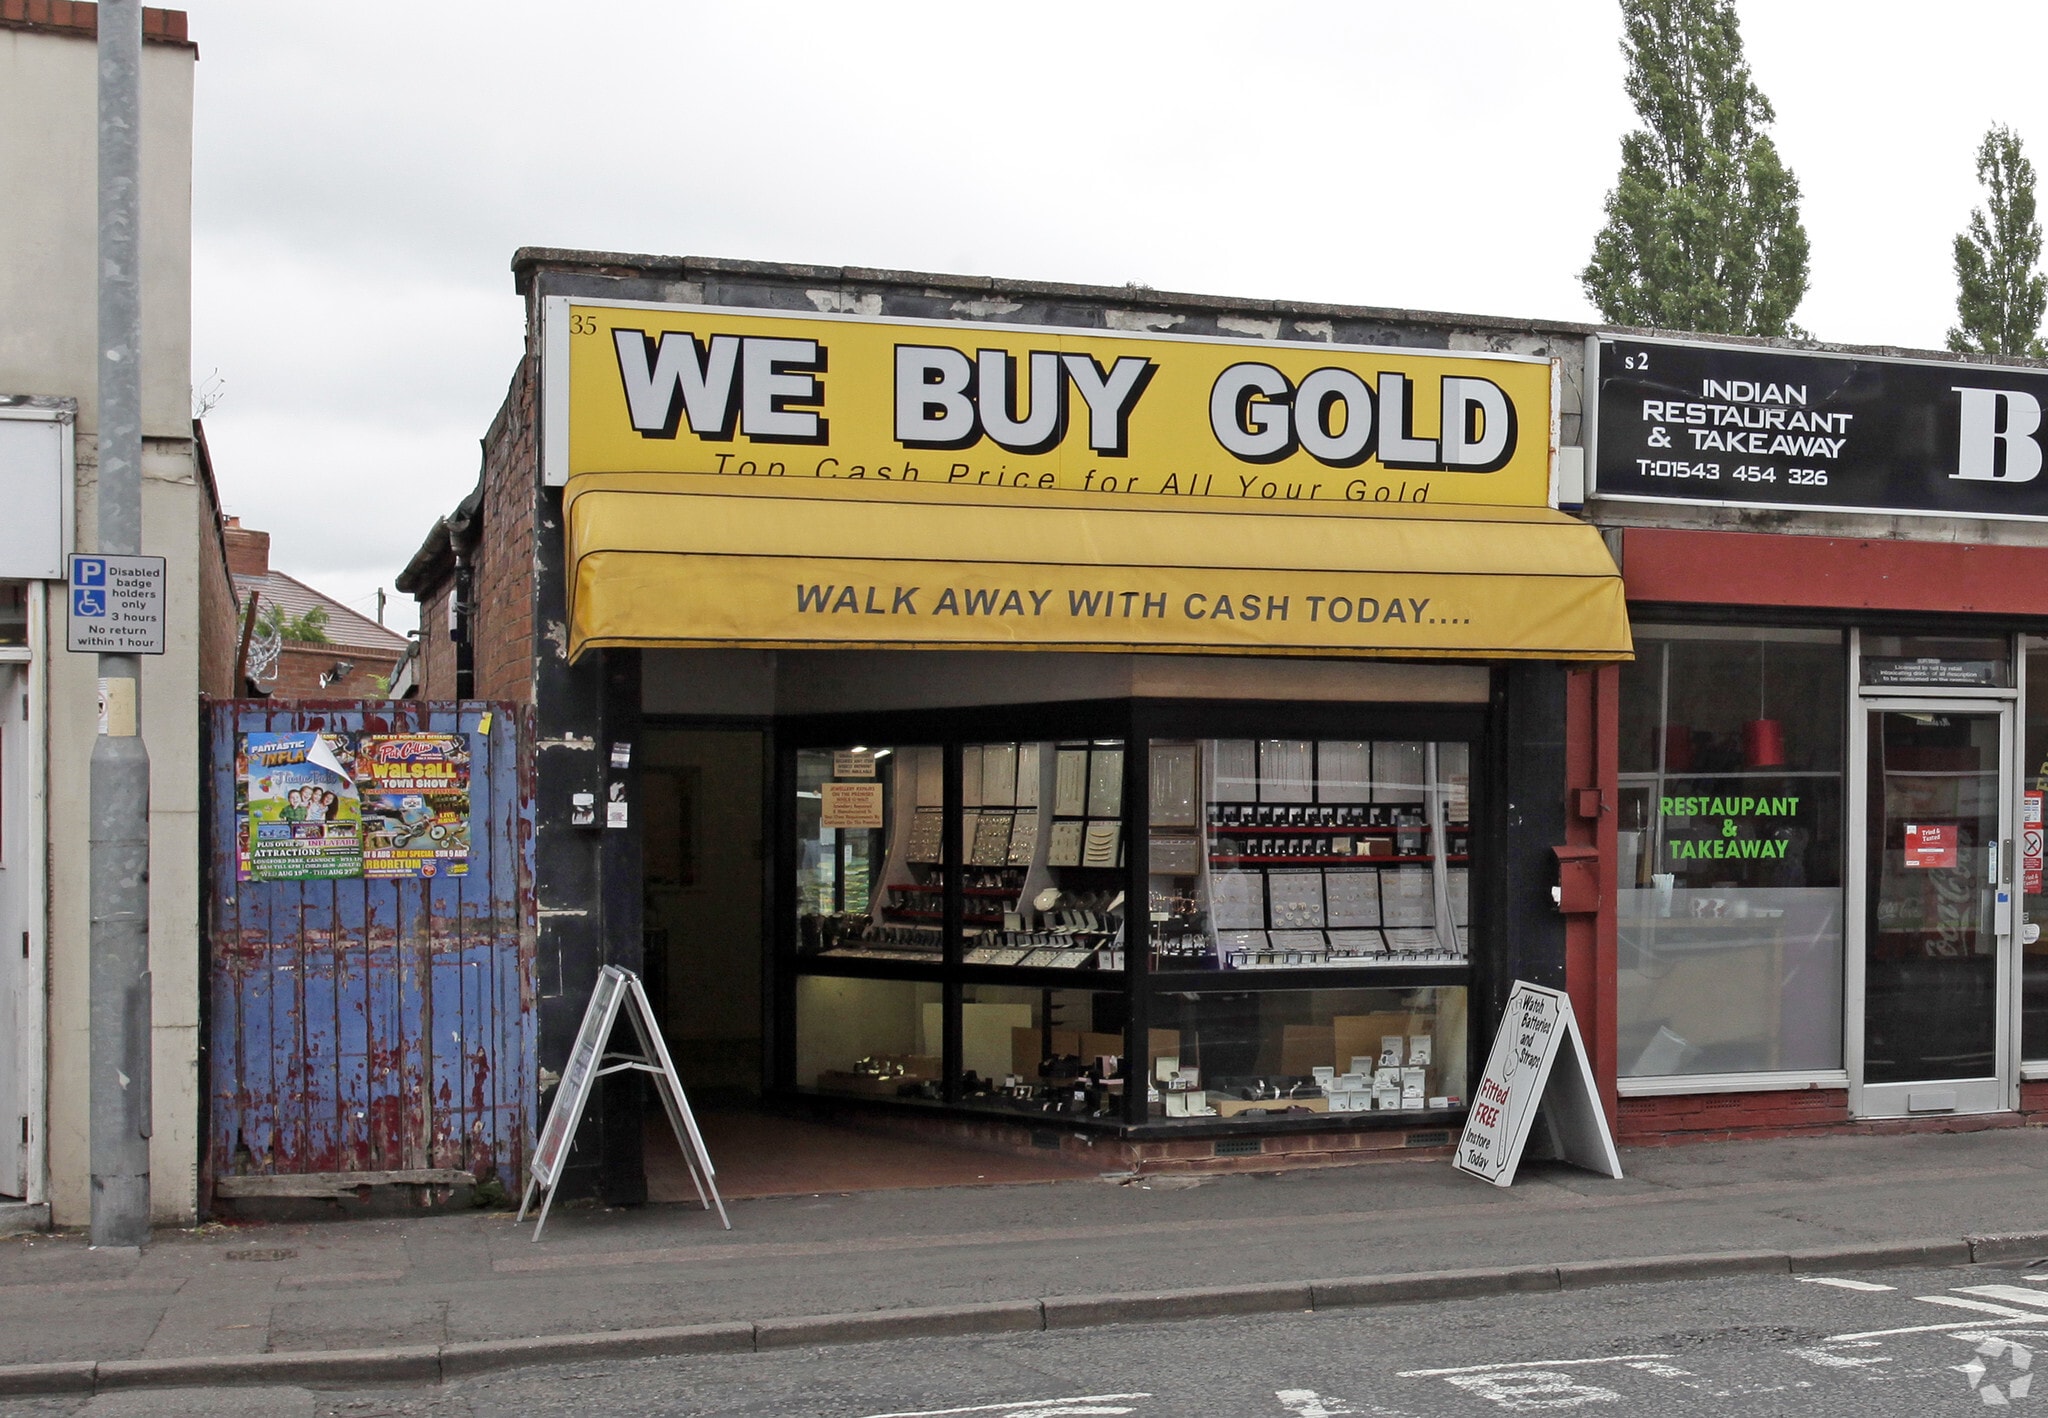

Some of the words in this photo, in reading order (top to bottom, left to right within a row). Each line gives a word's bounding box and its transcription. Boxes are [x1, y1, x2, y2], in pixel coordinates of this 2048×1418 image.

[569, 314, 597, 335] 35
[610, 327, 829, 446] WE
[893, 343, 1160, 458] BUY
[1209, 361, 1518, 474] GOLD
[1702, 379, 1807, 405] INDIAN
[1642, 400, 1853, 434] RESTAURANT
[1647, 426, 1672, 448] &
[1688, 429, 1846, 458] TAKEAWAY
[1948, 386, 2043, 482] B
[714, 453, 786, 475] Top
[815, 457, 919, 480] Cash
[947, 463, 1056, 488] Price
[1084, 469, 1138, 493] for
[1160, 472, 1213, 496] All
[1238, 475, 1322, 499] Your
[1345, 479, 1430, 503] Gold
[1636, 459, 1720, 479] T:01543
[1732, 465, 1777, 483] 454
[1788, 468, 1828, 486] 326
[82, 562, 101, 584] P
[109, 567, 160, 577] Disabled
[112, 589, 156, 598] holders
[117, 579, 152, 588] badge
[122, 601, 146, 610] only
[797, 584, 920, 615] WALK
[932, 588, 1052, 616] AWAY
[1068, 590, 1167, 618] WITH
[1184, 593, 1290, 621] CASH
[1306, 596, 1470, 624] TODAY....
[112, 612, 119, 621] 3
[124, 613, 157, 622] hours
[89, 625, 105, 634] No
[110, 627, 147, 635] return
[78, 637, 114, 646] within
[119, 638, 123, 646] 1
[128, 639, 154, 647] hour
[252, 740, 306, 753] FANTASTIC
[380, 745, 400, 764] Pat
[262, 748, 312, 767] INFLA
[382, 779, 414, 788] TOWN
[416, 779, 448, 788] SHOW
[1658, 796, 1799, 816] RESTAUPANT
[1721, 818, 1738, 837] &
[1922, 828, 1936, 836] Tried
[254, 848, 321, 857] ATTRACTIONS
[391, 850, 396, 858] 2
[409, 850, 434, 858] SPECIAL
[435, 850, 448, 858] SUN
[449, 850, 453, 858] 9
[454, 850, 468, 858] AUG
[1669, 839, 1789, 859] TAKEAWAY
[1521, 994, 1544, 1014] Watch
[1520, 1012, 1551, 1034] Batteries
[1519, 1032, 1534, 1047] and
[1518, 1049, 1541, 1069] Straps
[1481, 1077, 1510, 1106] Fitted
[1474, 1102, 1500, 1129] FREE
[1465, 1128, 1491, 1149] Instore
[1467, 1149, 1490, 1170] Today
